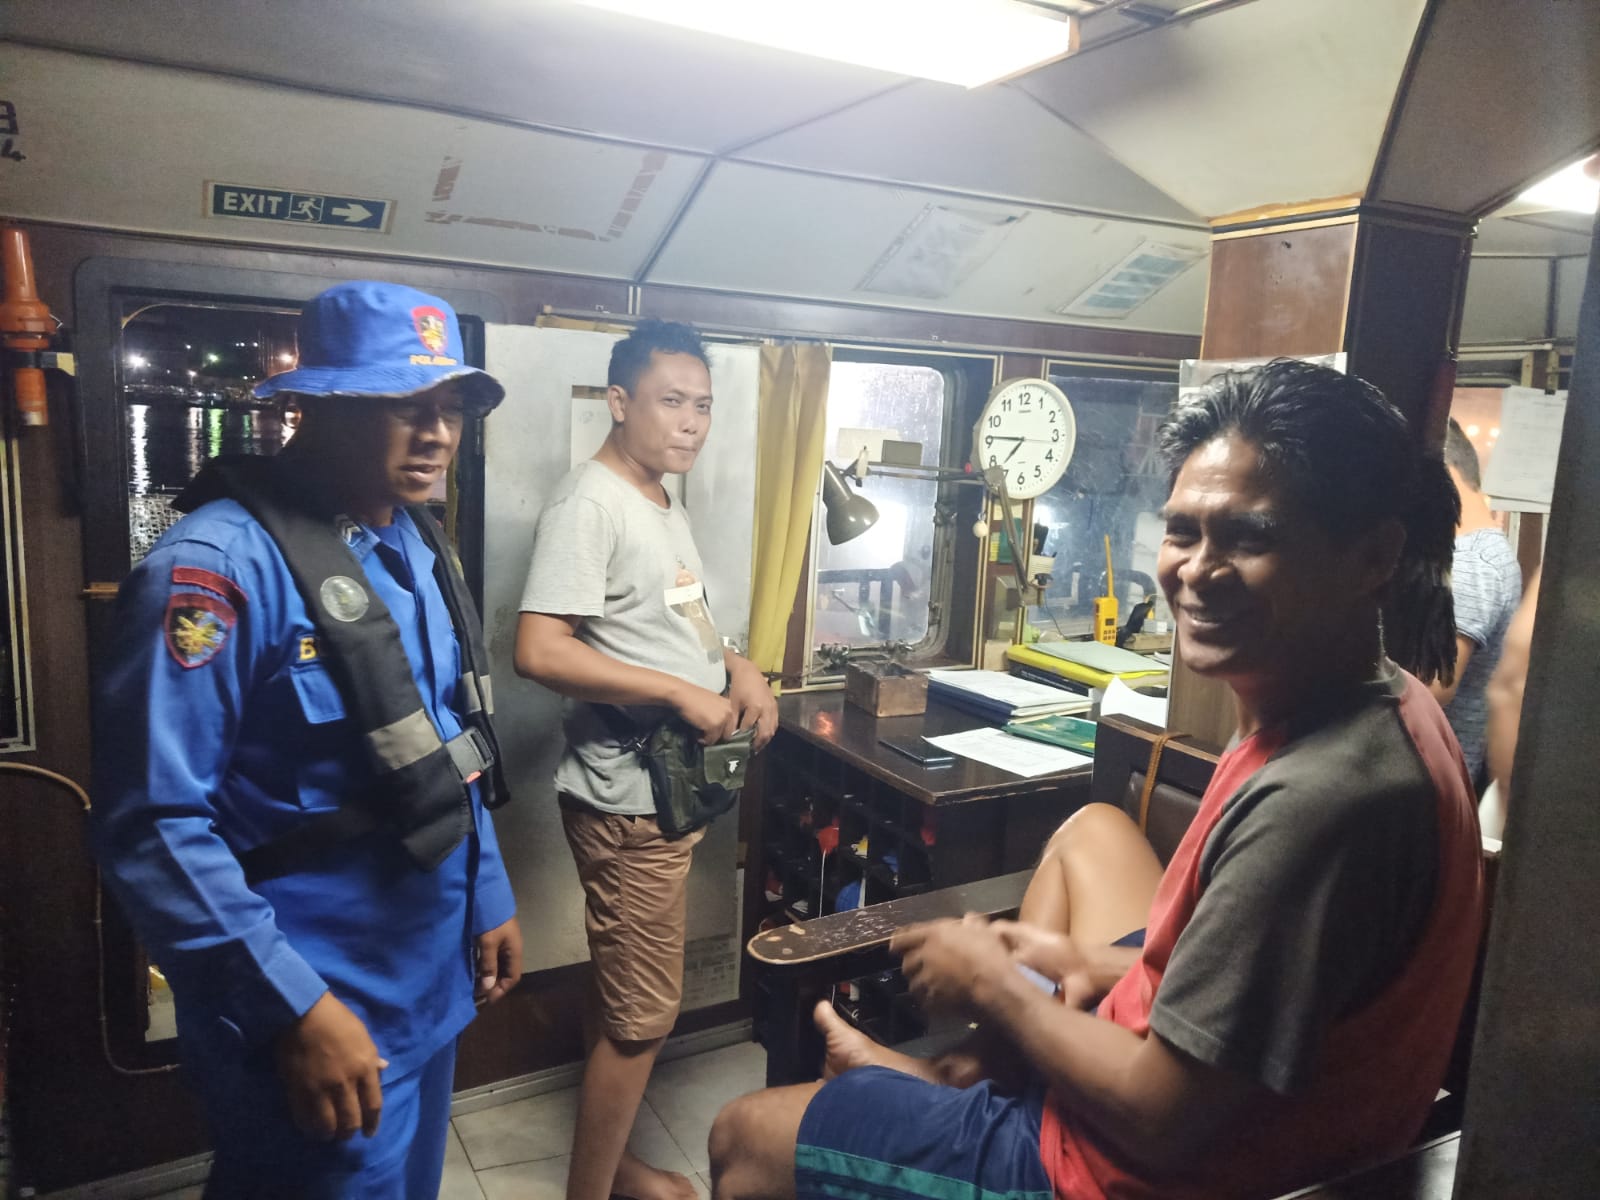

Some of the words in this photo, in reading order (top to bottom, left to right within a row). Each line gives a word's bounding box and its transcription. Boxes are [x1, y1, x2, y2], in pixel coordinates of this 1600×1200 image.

[223, 191, 283, 214] EXIT
[1001, 399, 1012, 412] 11
[1018, 392, 1031, 406] 12
[1038, 397, 1044, 410] 1
[988, 414, 1002, 428] 10
[1048, 410, 1056, 423] 2
[985, 434, 994, 448] 9
[1051, 428, 1060, 442] 3
[989, 455, 998, 467] 8
[1045, 448, 1054, 462] 4
[1033, 465, 1042, 478] 5
[1017, 472, 1025, 485] 6
